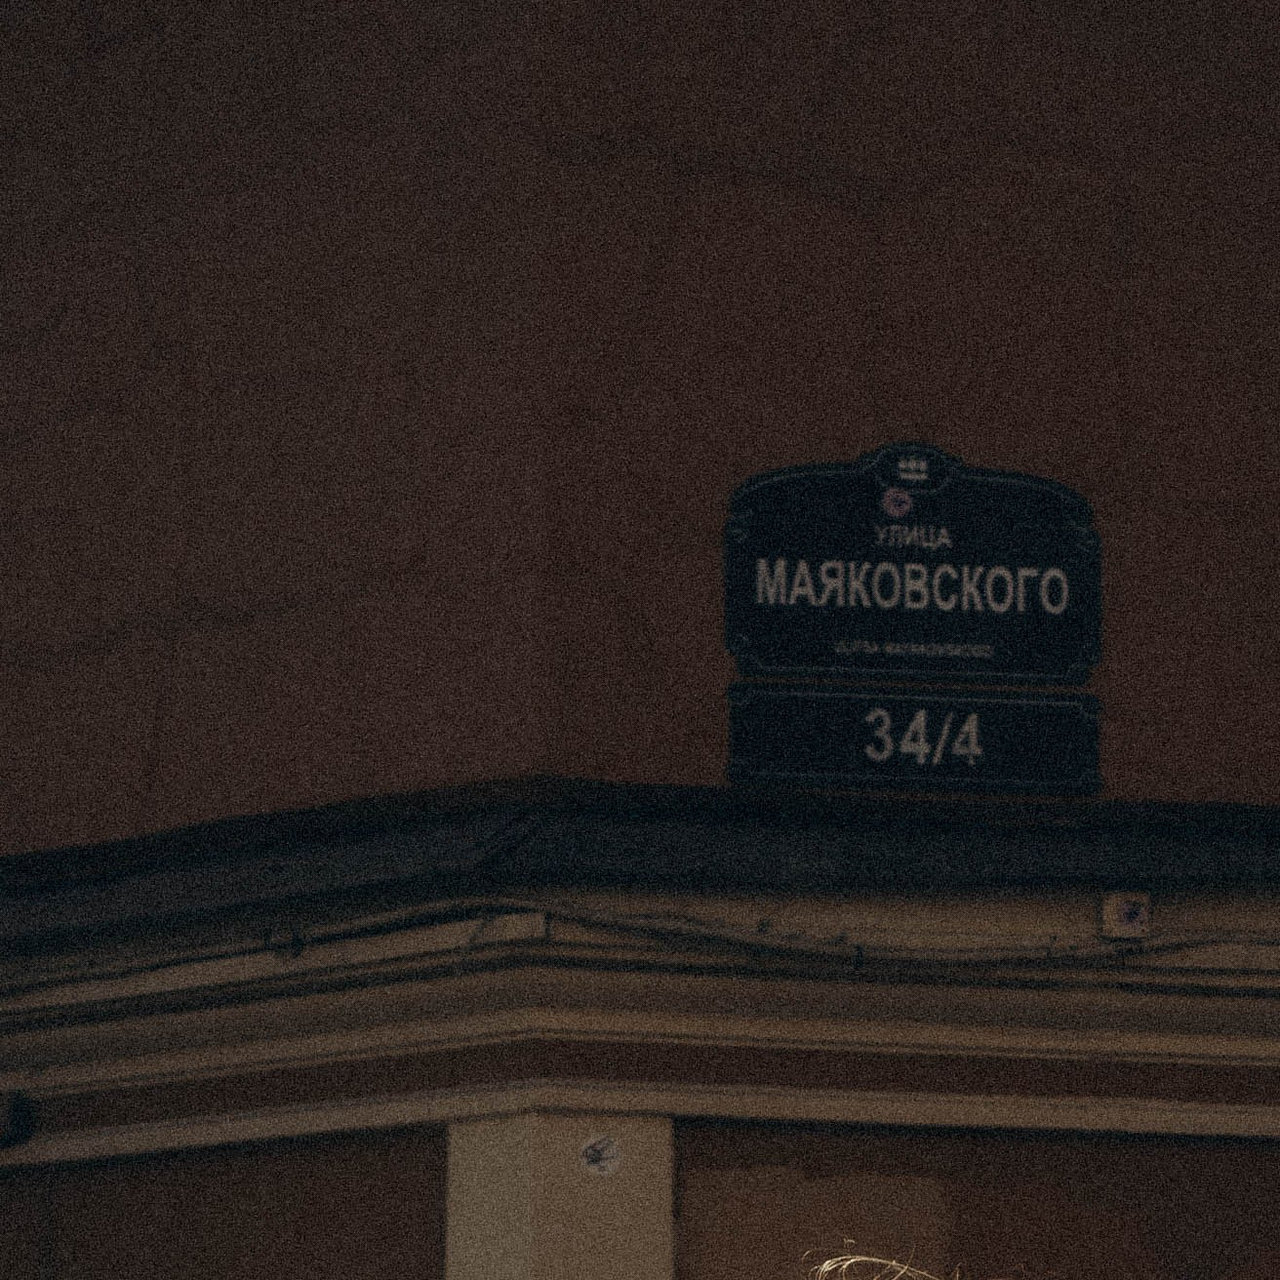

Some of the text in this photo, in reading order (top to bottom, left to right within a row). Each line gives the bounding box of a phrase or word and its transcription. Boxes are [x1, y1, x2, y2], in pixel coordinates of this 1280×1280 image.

[875, 524, 953, 550] УЛИЦА
[755, 557, 1069, 615] МАЯКОВСКОГО
[864, 707, 983, 766] 34/4
